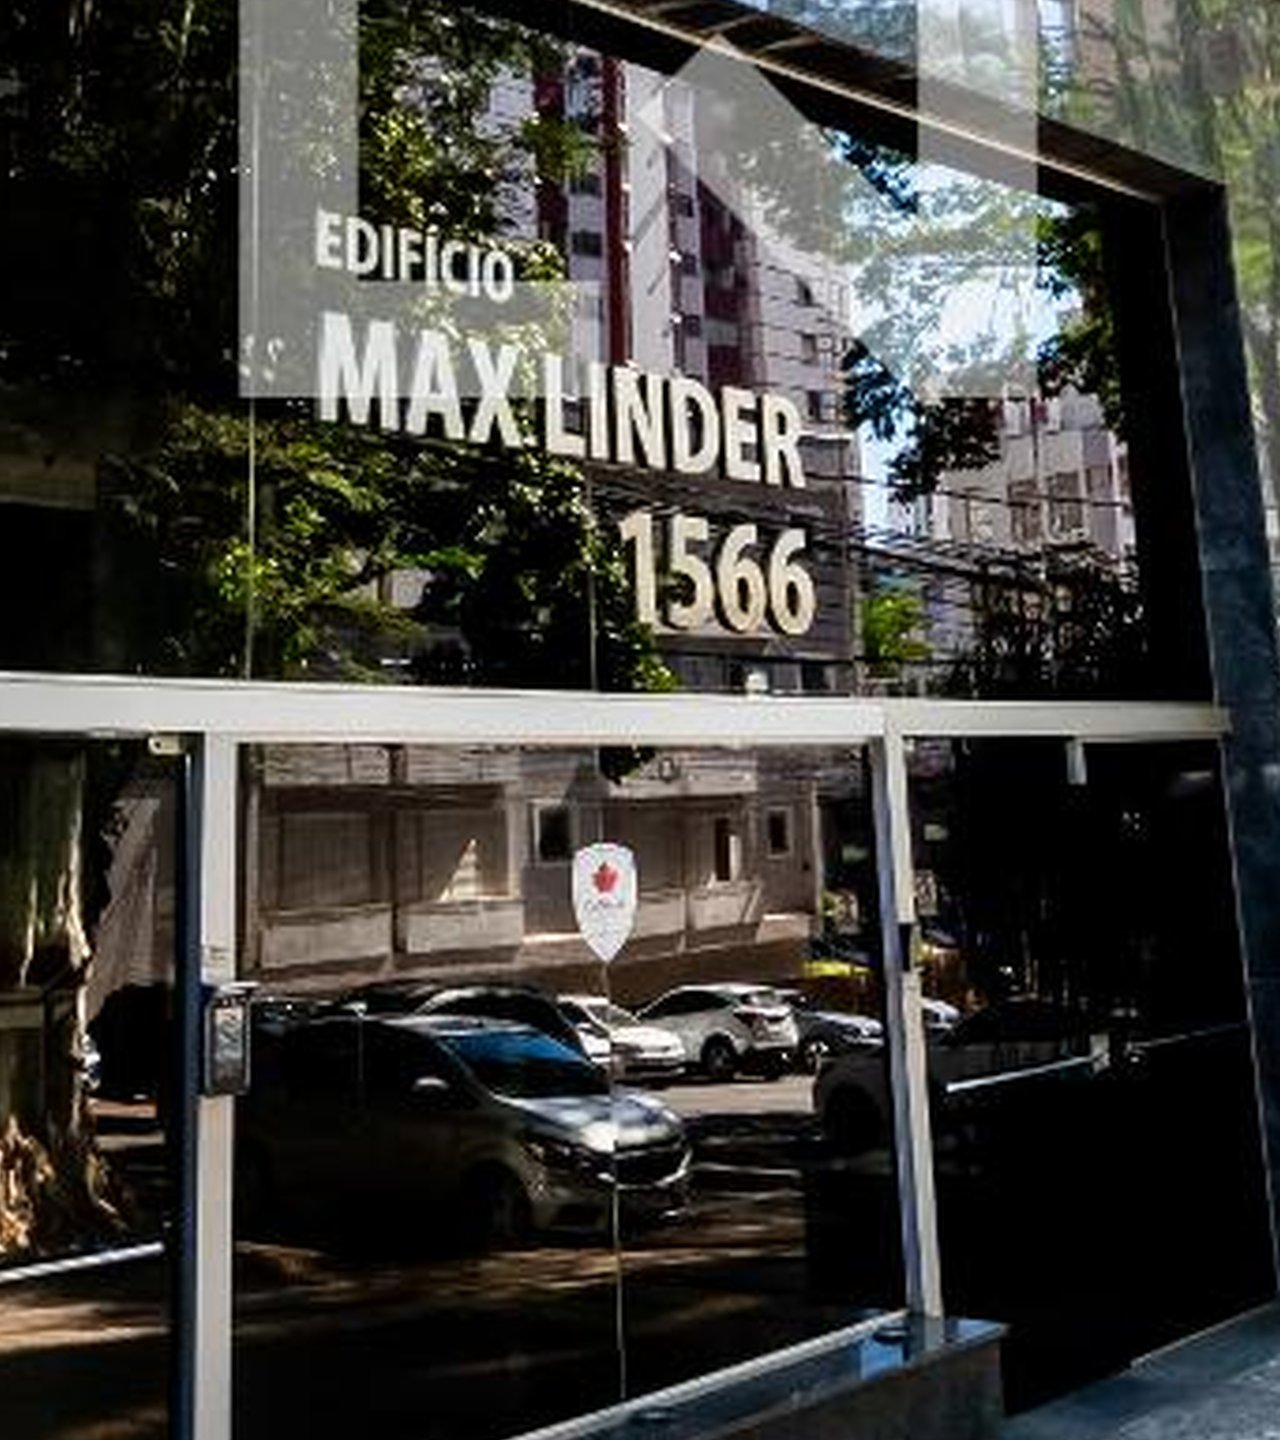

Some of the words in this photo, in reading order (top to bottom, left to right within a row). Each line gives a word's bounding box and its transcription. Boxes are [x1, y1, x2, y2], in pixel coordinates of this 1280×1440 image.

[319, 310, 521, 448] MAX
[544, 353, 806, 488] LINDER
[620, 513, 816, 635] 1566
